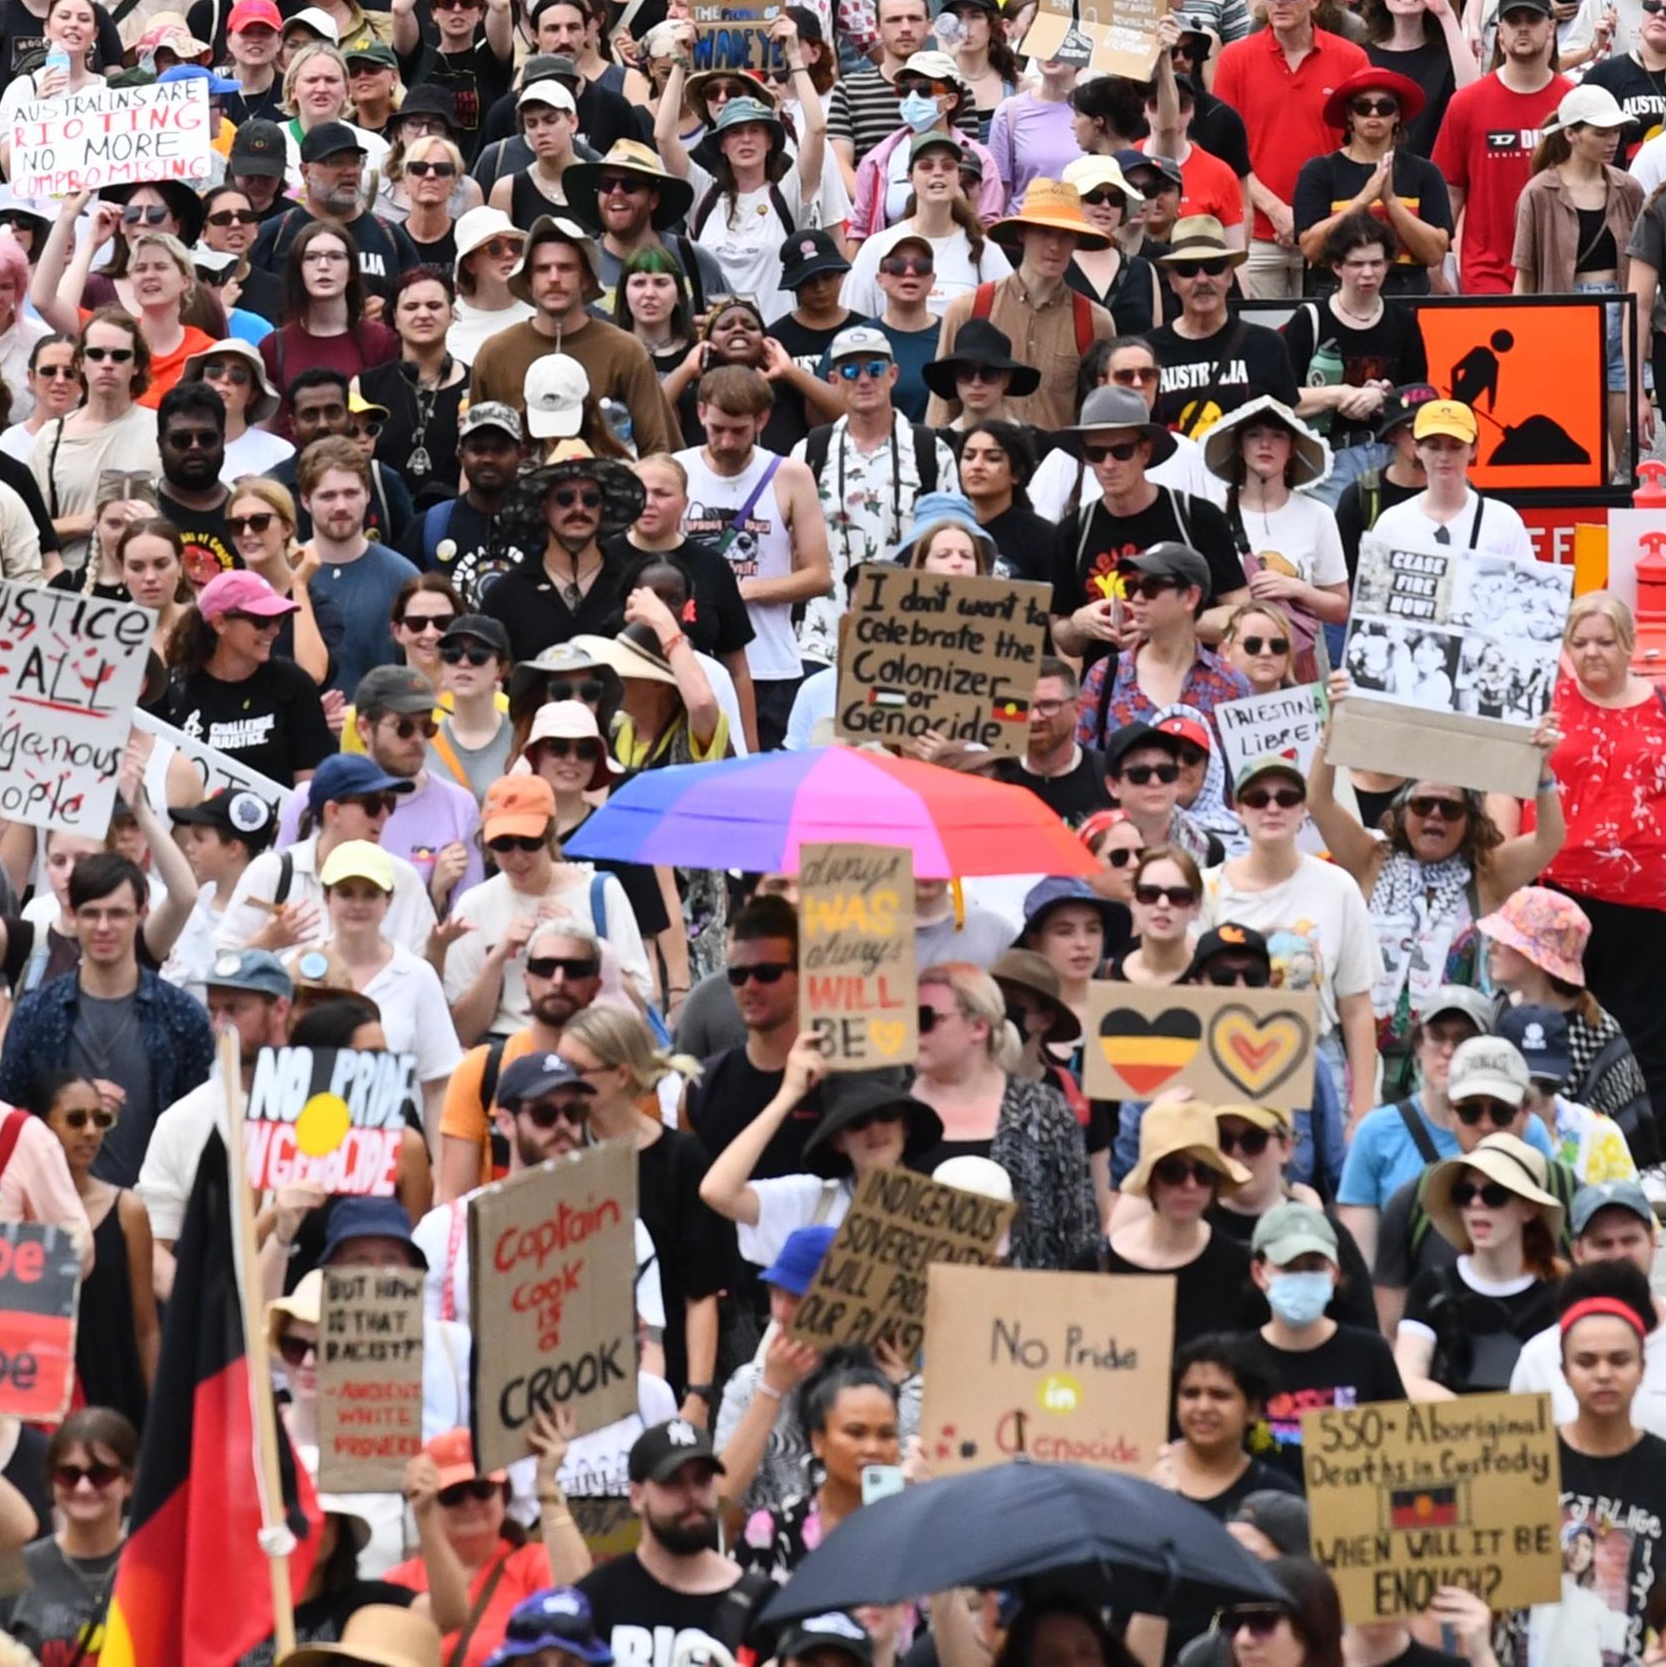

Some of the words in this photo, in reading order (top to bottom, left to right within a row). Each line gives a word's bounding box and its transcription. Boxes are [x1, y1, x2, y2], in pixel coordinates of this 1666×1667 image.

[155, 81, 200, 104] ARE
[15, 98, 202, 149] RIOTING
[22, 148, 55, 172] NO
[83, 131, 179, 166] MORE
[13, 156, 206, 200] COMPROMISING
[1392, 551, 1447, 575] CEASE
[862, 572, 887, 612] I
[994, 624, 1034, 663] the
[853, 654, 1011, 697] Colonizer
[907, 690, 937, 711] or
[1223, 696, 1323, 729] PALESTINA
[804, 895, 901, 935] WAS
[808, 976, 904, 1011] WILL
[811, 1018, 866, 1059] BE
[250, 1045, 313, 1124] NO
[331, 1047, 417, 1132] PRIDE
[874, 1176, 1007, 1242] INDIGENOUS
[493, 1196, 620, 1275] Captain
[375, 1277, 418, 1301] HOW
[354, 1312, 405, 1334] THAT
[989, 1317, 1049, 1370] No
[1064, 1324, 1138, 1371] Pride
[499, 1340, 626, 1431] CROOK
[339, 1406, 408, 1426] WHITE
[996, 1408, 1142, 1462] Genocide
[1405, 1395, 1546, 1455] Aboriginal
[1307, 1453, 1403, 1490] Deaths
[1437, 1446, 1548, 1486] Custody
[1314, 1534, 1389, 1569] WHEN
[1404, 1531, 1459, 1559] WILL
[1470, 1529, 1501, 1555] IT
[1514, 1524, 1550, 1553] BE
